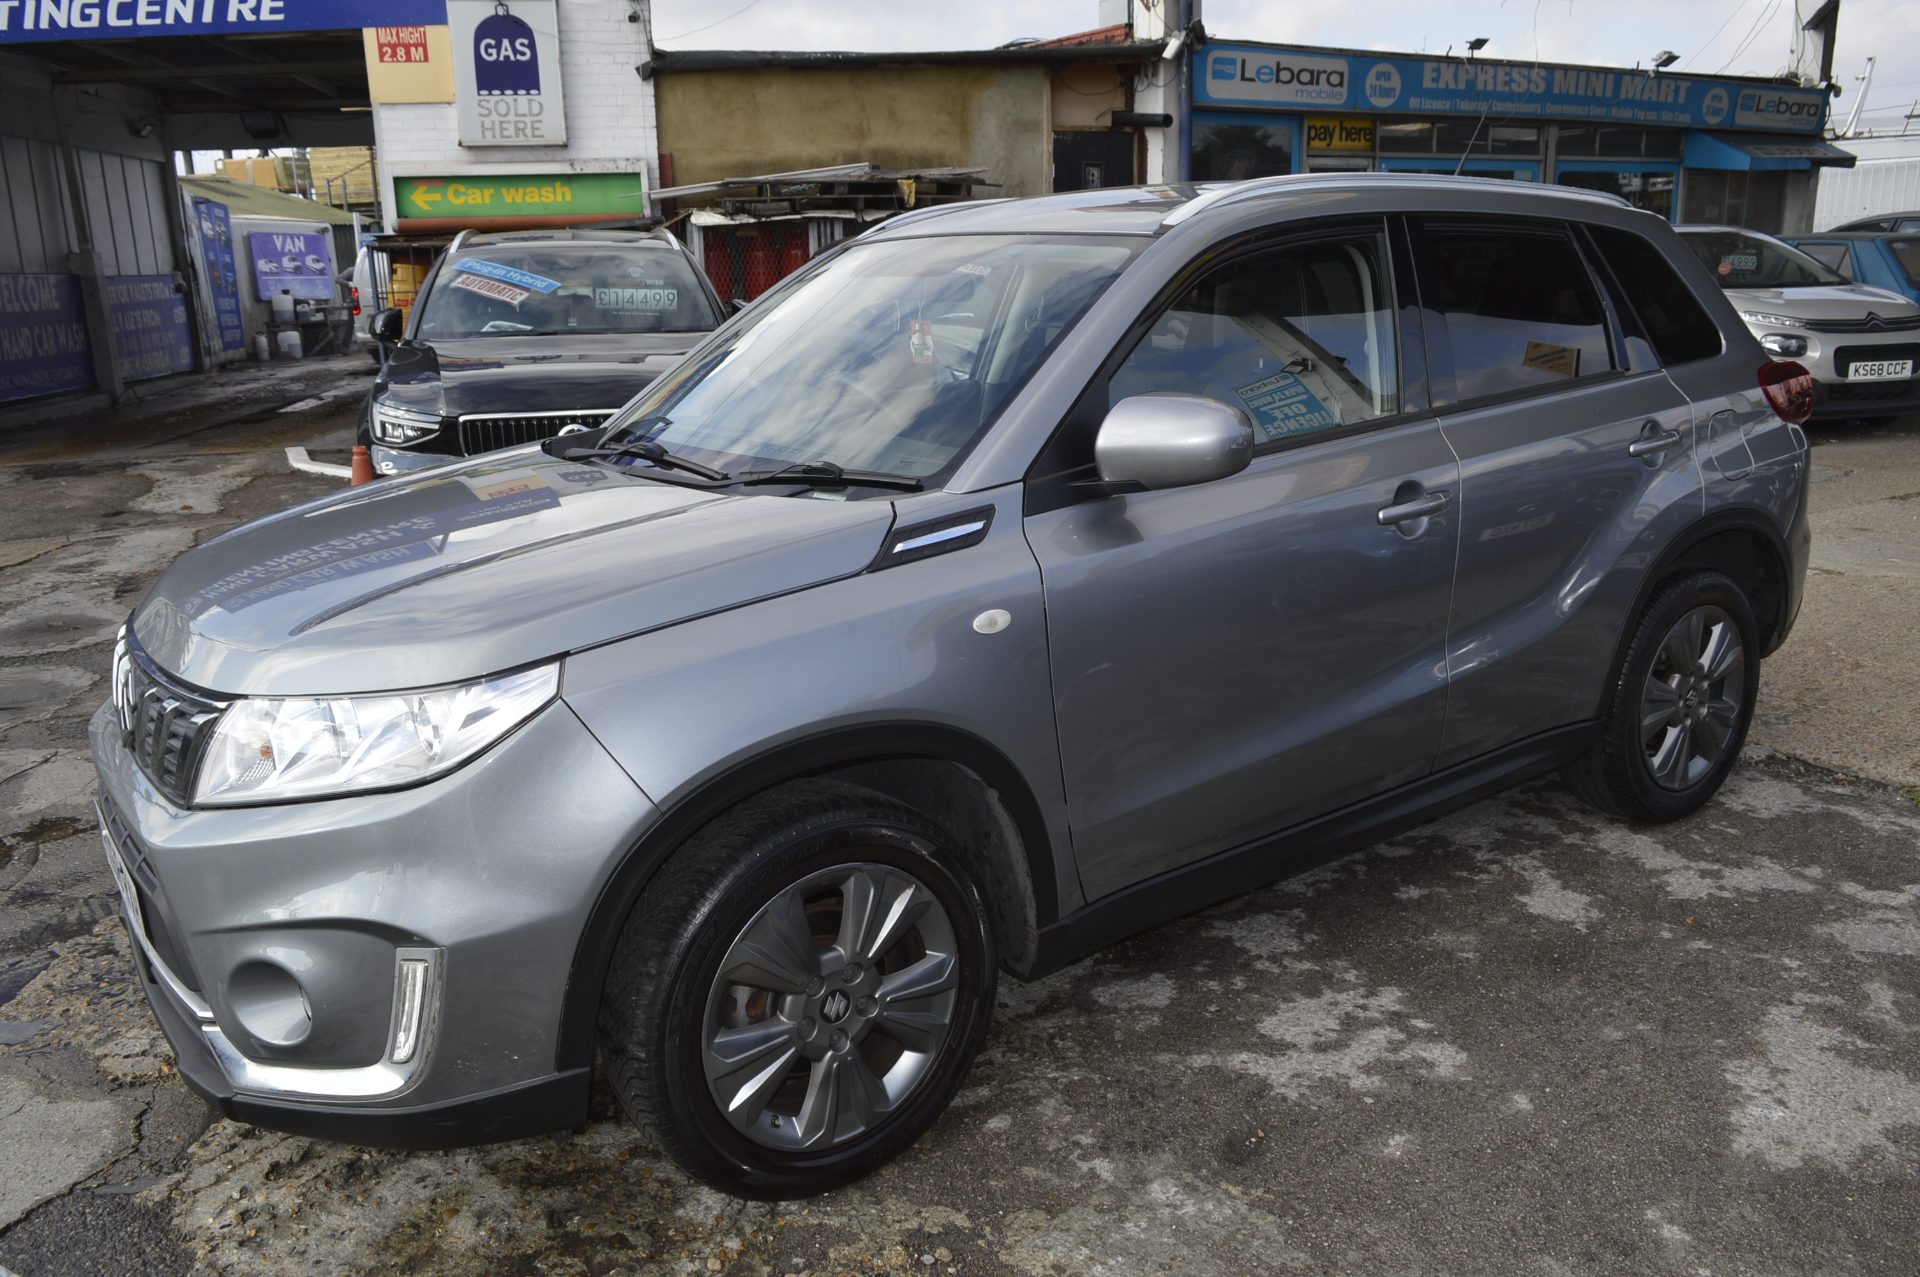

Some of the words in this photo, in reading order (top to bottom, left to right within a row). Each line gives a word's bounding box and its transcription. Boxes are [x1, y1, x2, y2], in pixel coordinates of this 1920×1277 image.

[378, 27, 398, 44] MAX
[400, 27, 426, 44] HIGHT
[383, 47, 406, 62] 2.8
[411, 47, 424, 61] M
[480, 38, 531, 61] GAS
[1240, 58, 1345, 88] Lebara
[1375, 70, 1392, 82] OPEN
[1423, 61, 1547, 94] EXPRESS
[1553, 69, 1614, 98] MINI
[1620, 74, 1691, 104] MART
[1295, 88, 1344, 100] mobile
[1369, 83, 1378, 98] 24
[477, 98, 544, 118] SOLD
[1755, 94, 1819, 117] Lebara
[480, 119, 544, 139] HERE
[1307, 123, 1335, 147] pay
[1339, 120, 1374, 143] here
[447, 183, 495, 205] Car
[501, 181, 572, 204] wash
[273, 234, 306, 253] VAN
[464, 260, 507, 278] Plug-in
[508, 270, 549, 289] Hybrid
[0, 274, 61, 313] ELCOME
[457, 276, 525, 302] AUTOMATIC
[598, 291, 676, 308] £14499
[1853, 363, 1884, 377] KS68
[1886, 362, 1908, 376] CCF
